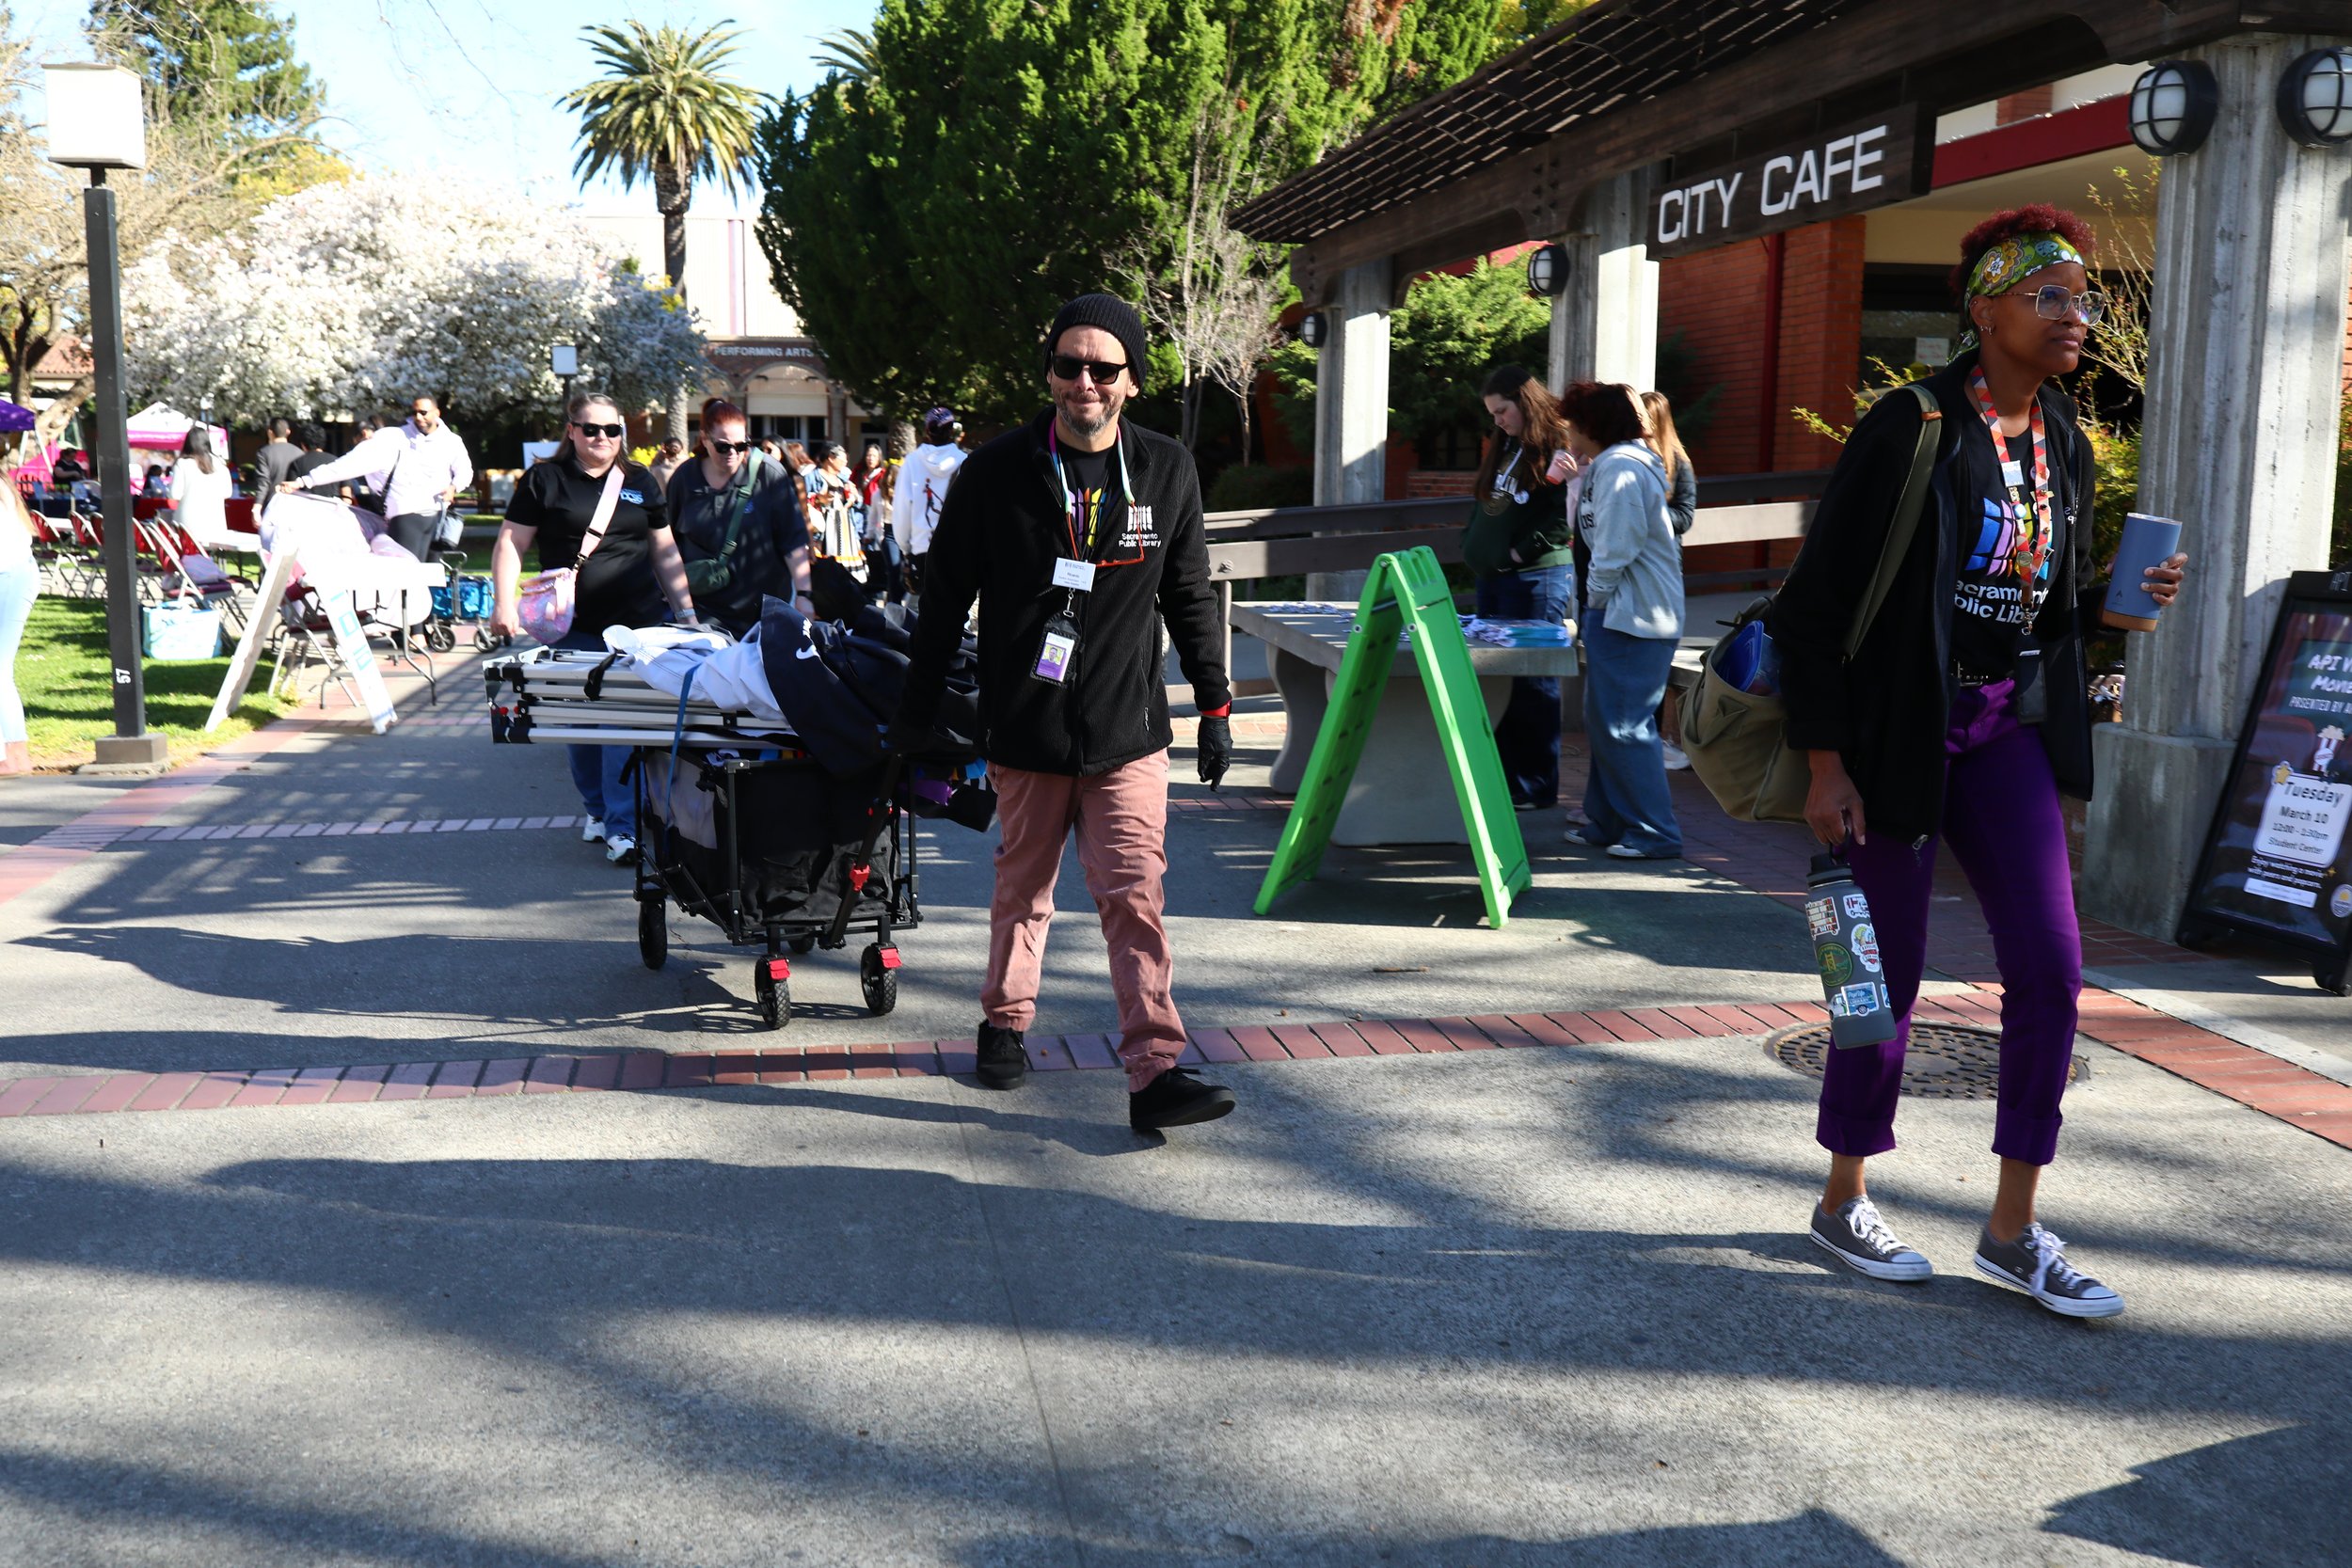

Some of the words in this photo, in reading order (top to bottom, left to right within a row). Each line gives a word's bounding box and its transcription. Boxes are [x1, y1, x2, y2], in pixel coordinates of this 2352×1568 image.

[1659, 171, 1743, 244] CITY
[1760, 124, 1888, 216] CAFE
[713, 345, 783, 357] PERFORMING
[785, 347, 815, 357] ARTS
[1119, 539, 1137, 547] Public
[1954, 594, 1994, 618] blic
[115, 667, 132, 684] 57
[2284, 782, 2344, 808] Tuesday
[2280, 805, 2312, 821] March
[2313, 813, 2329, 824] 10
[2268, 836, 2296, 850] Student
